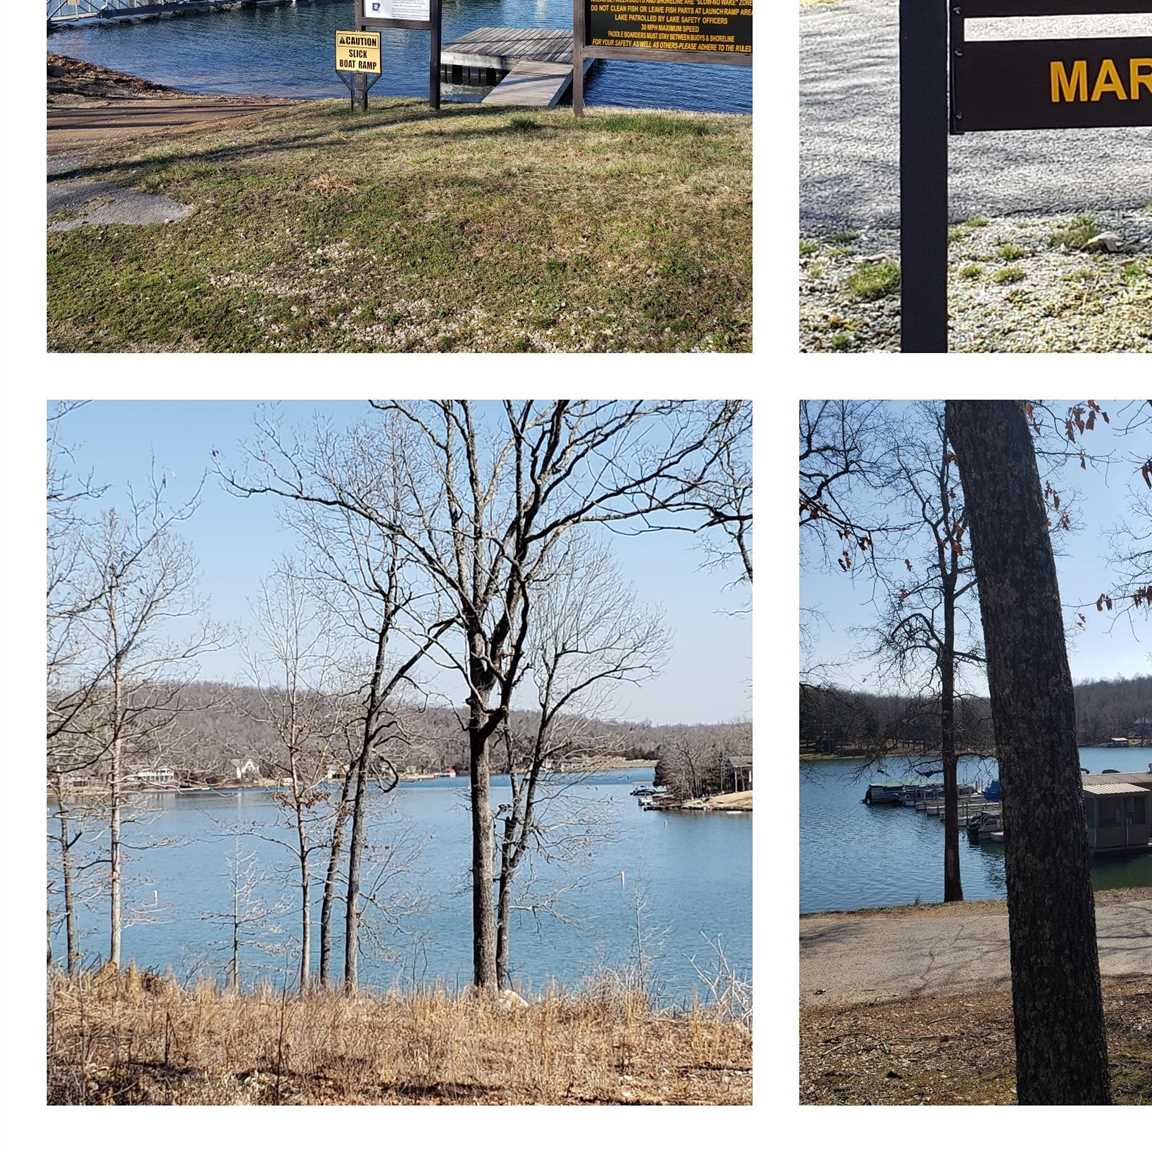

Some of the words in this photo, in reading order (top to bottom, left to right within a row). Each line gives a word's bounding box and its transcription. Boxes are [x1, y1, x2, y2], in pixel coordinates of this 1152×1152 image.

[345, 36, 376, 46] CAUTION
[348, 49, 368, 58] SLICK
[339, 60, 356, 68] BOAT
[358, 60, 377, 70] RAMP
